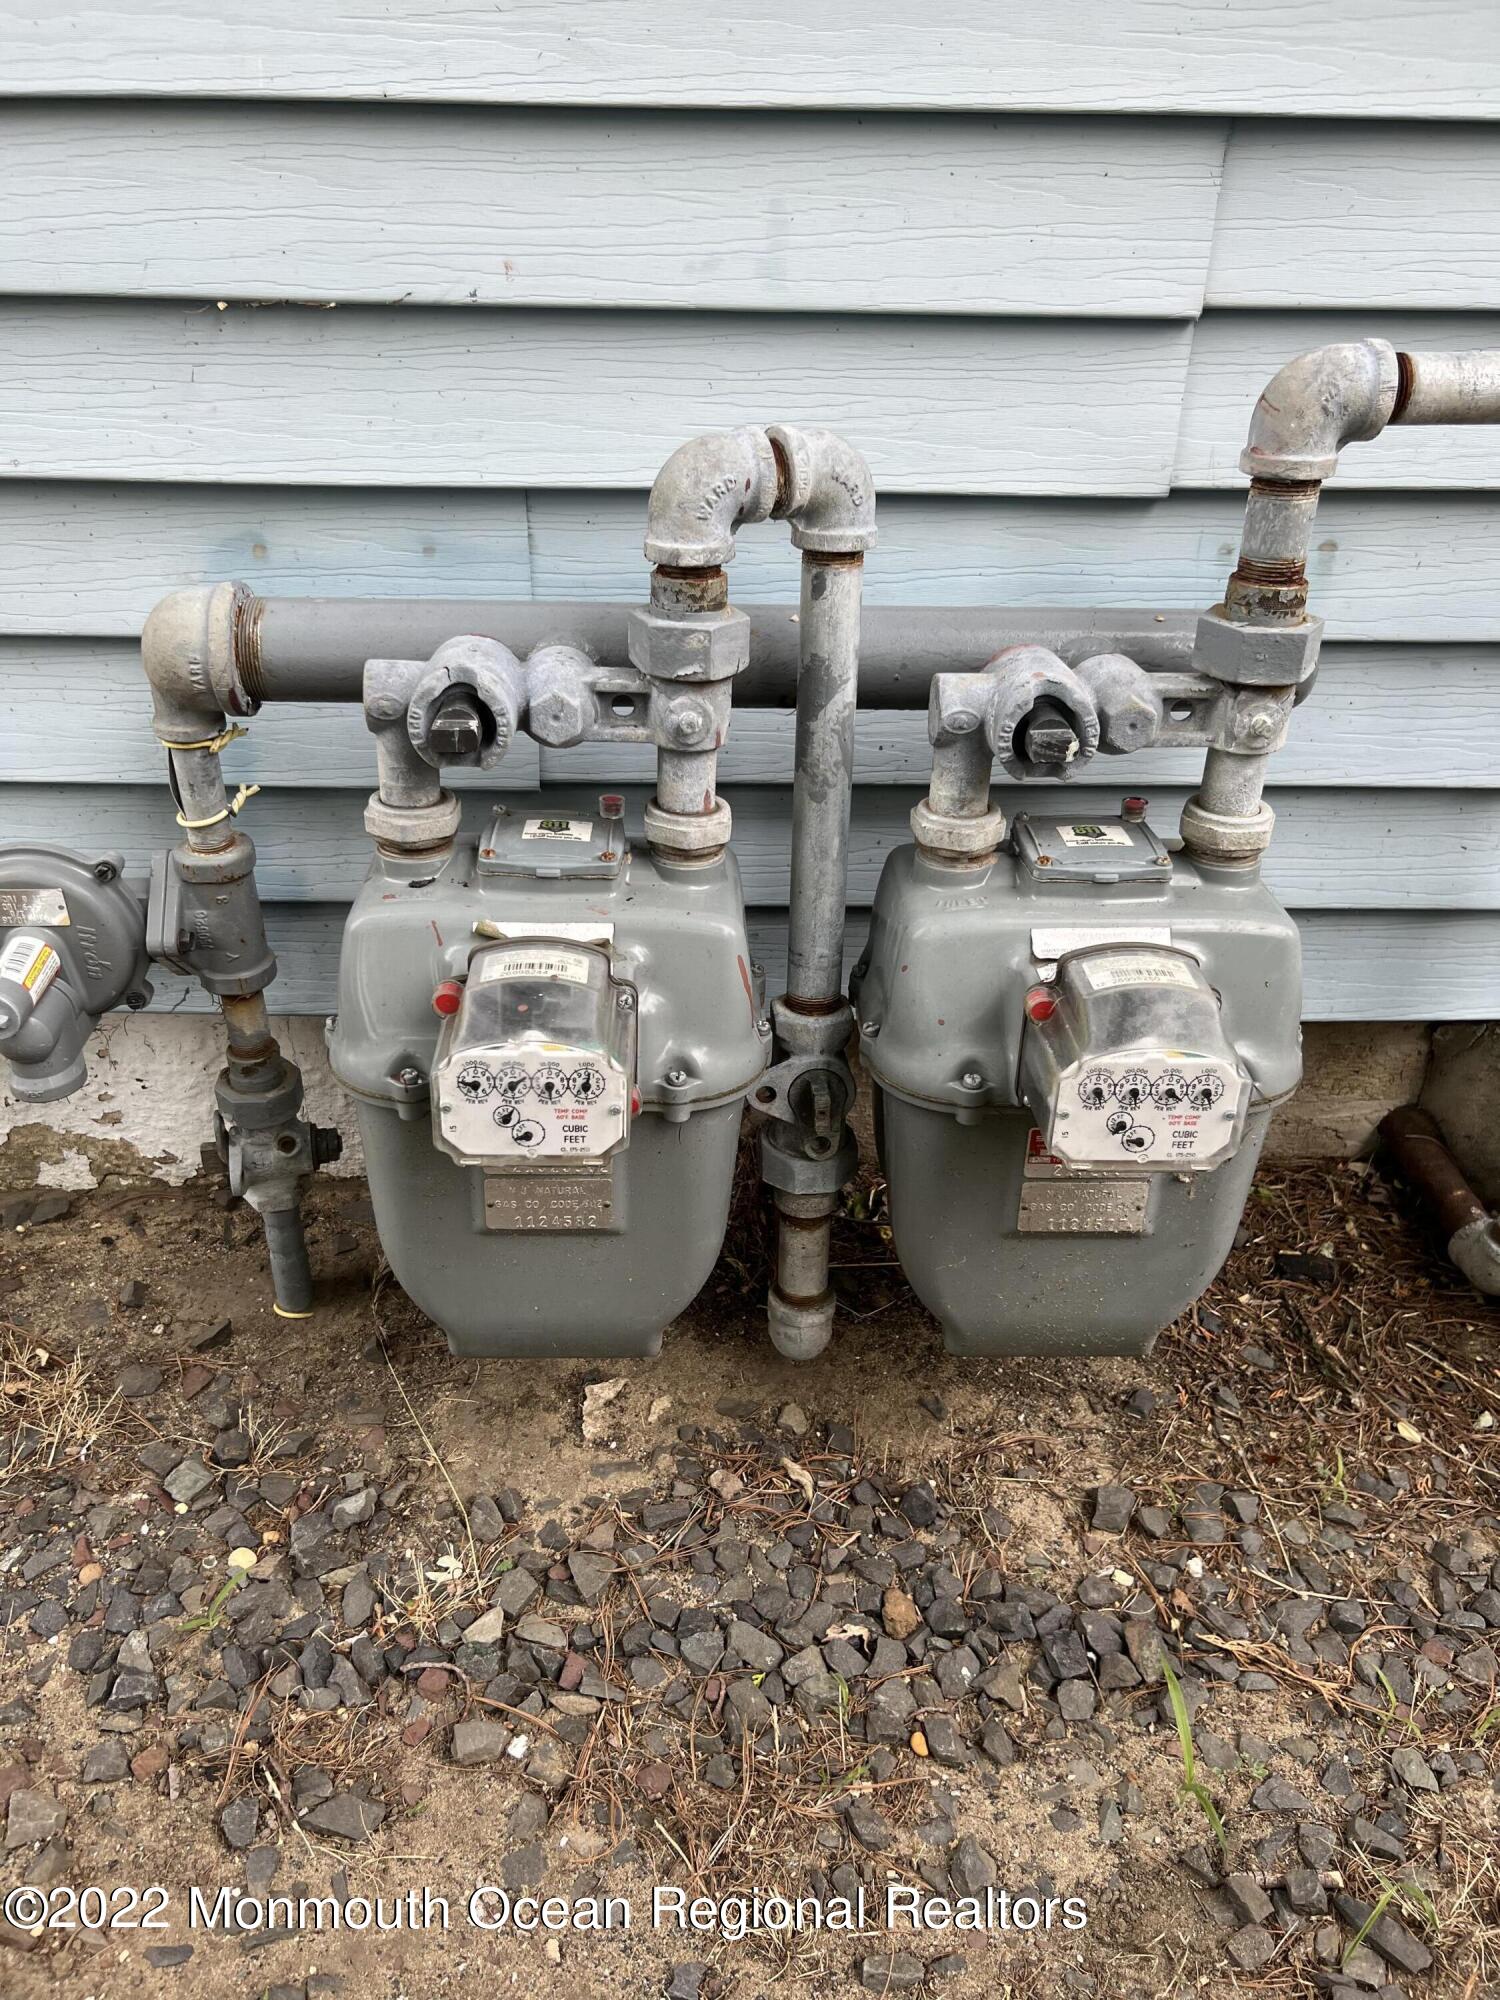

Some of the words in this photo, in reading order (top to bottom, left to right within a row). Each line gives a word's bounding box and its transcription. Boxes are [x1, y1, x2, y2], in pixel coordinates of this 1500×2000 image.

[696, 473, 737, 520] WARD
[535, 1186, 586, 1196] NATURAL
[495, 1199, 517, 1209] GAS
